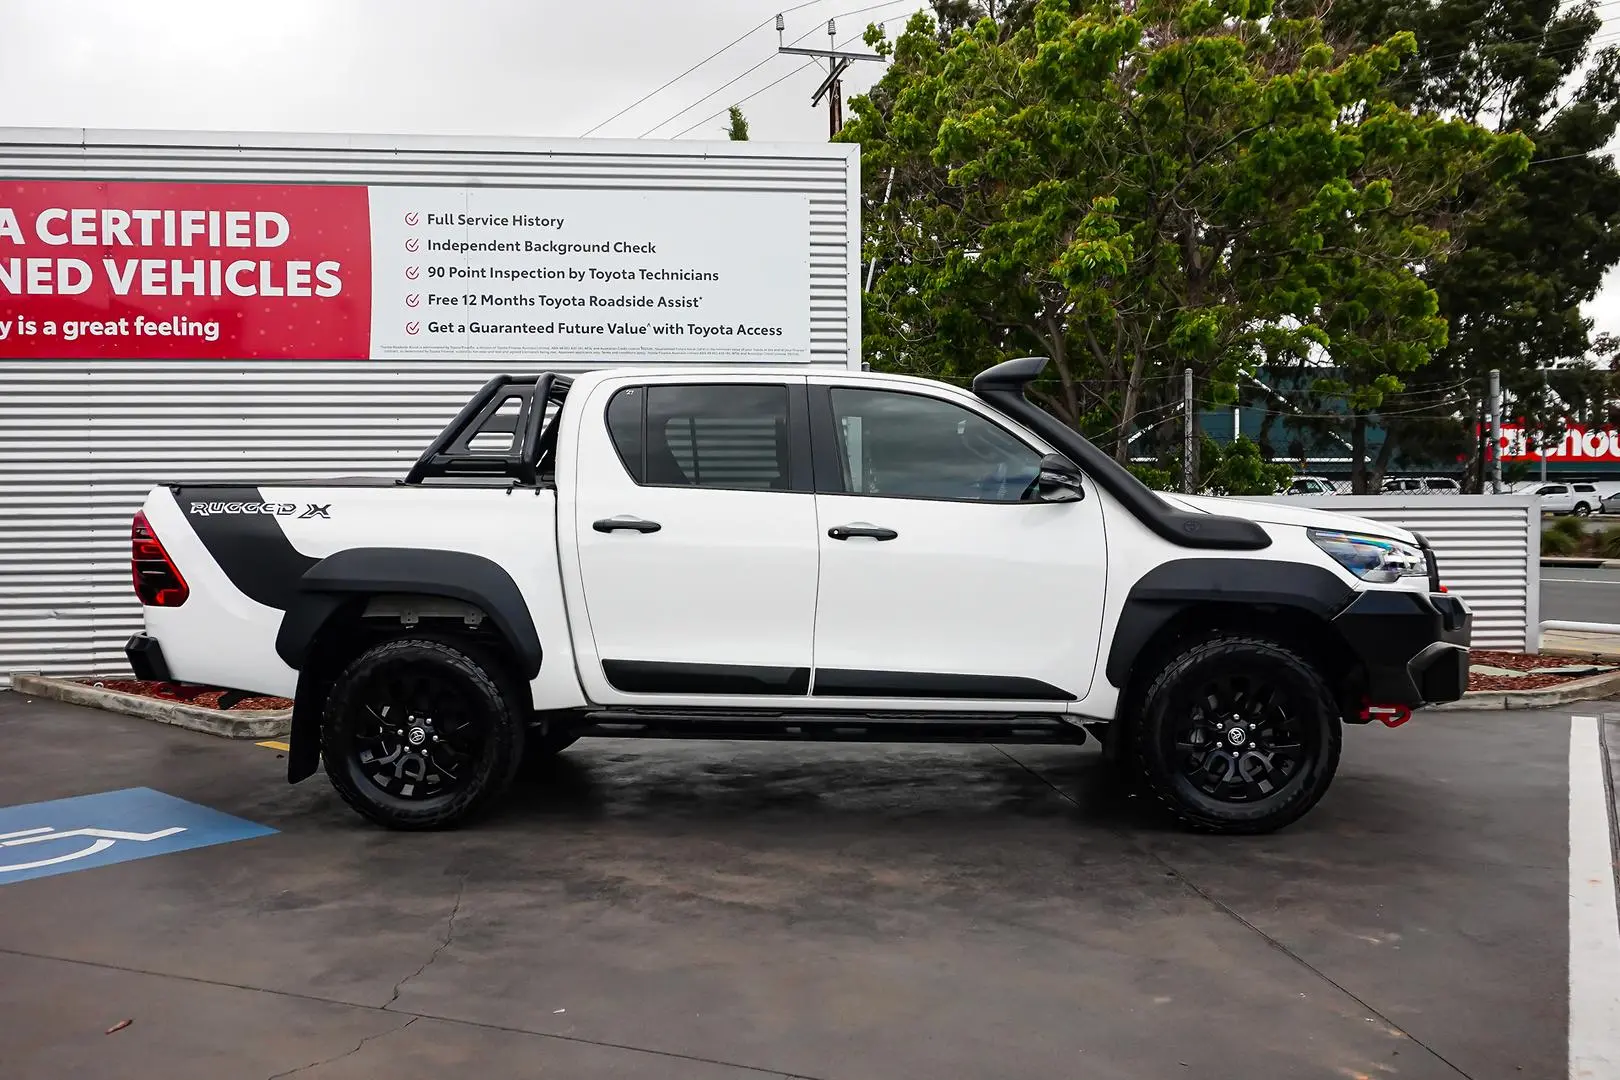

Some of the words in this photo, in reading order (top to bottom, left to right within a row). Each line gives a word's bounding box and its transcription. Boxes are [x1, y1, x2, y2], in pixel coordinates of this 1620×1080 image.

[36, 208, 290, 247] CERTIFIED
[427, 213, 455, 226] Full
[457, 213, 509, 227] Service
[512, 214, 565, 230] History
[427, 238, 521, 254] Independent
[524, 240, 610, 256] Background
[613, 241, 657, 254] Check
[103, 259, 342, 298] VEHICLES
[427, 266, 445, 279] 90
[449, 266, 487, 279] Point
[490, 266, 565, 282] Inspection
[568, 267, 586, 283] by
[588, 268, 636, 283] Toyota
[638, 268, 719, 281] Technicians
[428, 293, 459, 306] Free
[461, 294, 477, 306] 12
[481, 294, 536, 307] Months
[538, 294, 586, 310] Toyota
[589, 295, 654, 308] Roadside
[18, 315, 37, 335] is
[43, 321, 57, 335] a
[62, 317, 130, 341] great
[134, 315, 219, 342] feeling
[427, 320, 455, 334] Get
[457, 324, 466, 334] a
[469, 320, 554, 334] Guaranteed
[558, 322, 605, 335] Future
[653, 322, 684, 335] with
[687, 323, 733, 338] Toyota
[736, 323, 783, 336] Access
[190, 502, 297, 516] RUGGED
[297, 503, 332, 519] X
